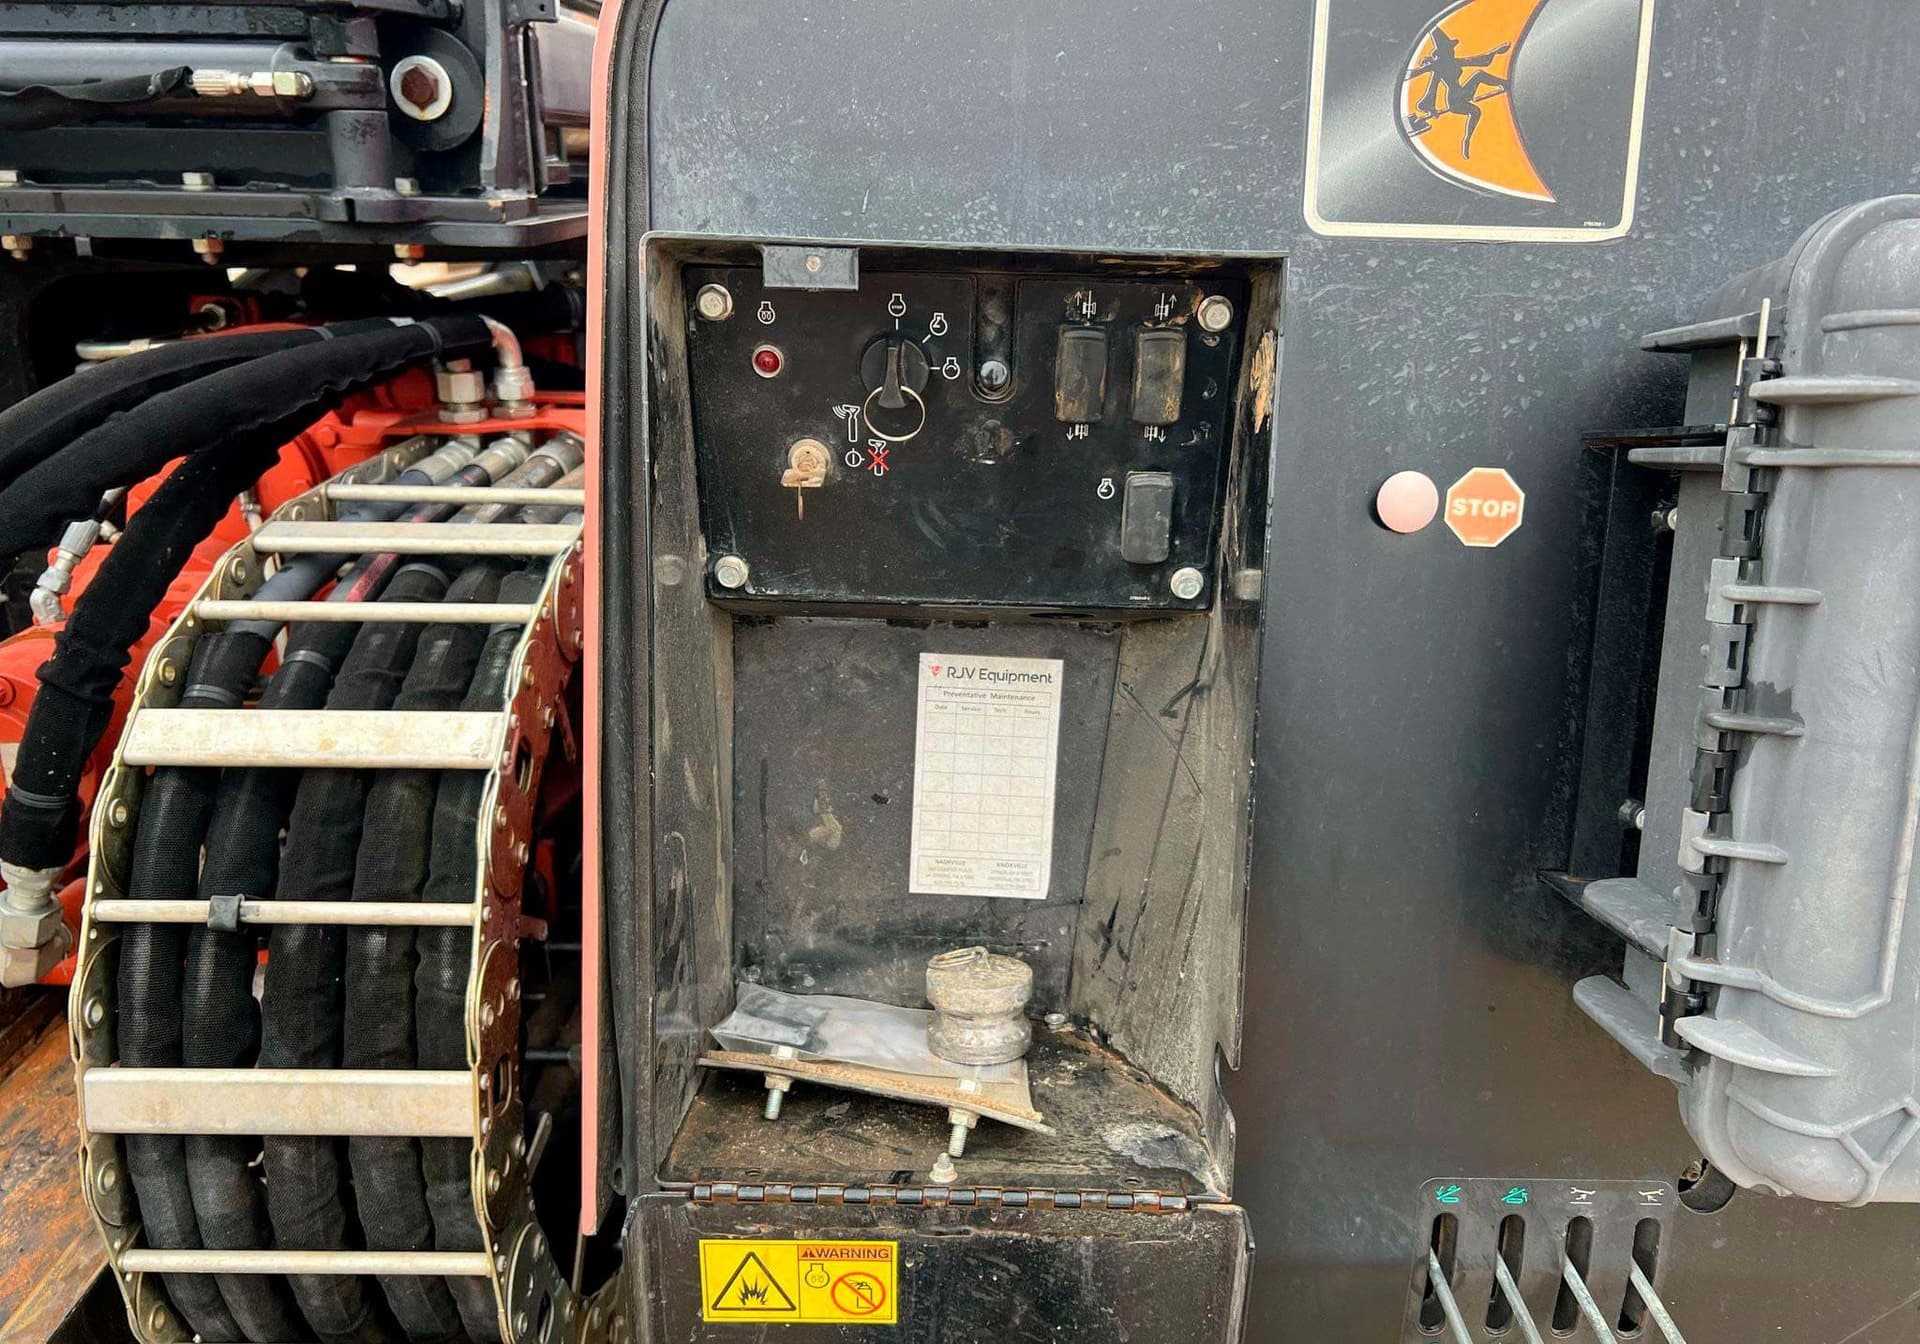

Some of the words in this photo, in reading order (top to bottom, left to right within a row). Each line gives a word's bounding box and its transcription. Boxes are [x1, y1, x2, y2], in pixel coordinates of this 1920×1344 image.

[1452, 498, 1517, 518] STOP
[947, 666, 976, 680] RJV
[979, 668, 1053, 685] Equipment
[943, 690, 987, 699] Preventative
[990, 693, 1036, 702] Maintenance
[815, 1248, 889, 1259] WARNING
